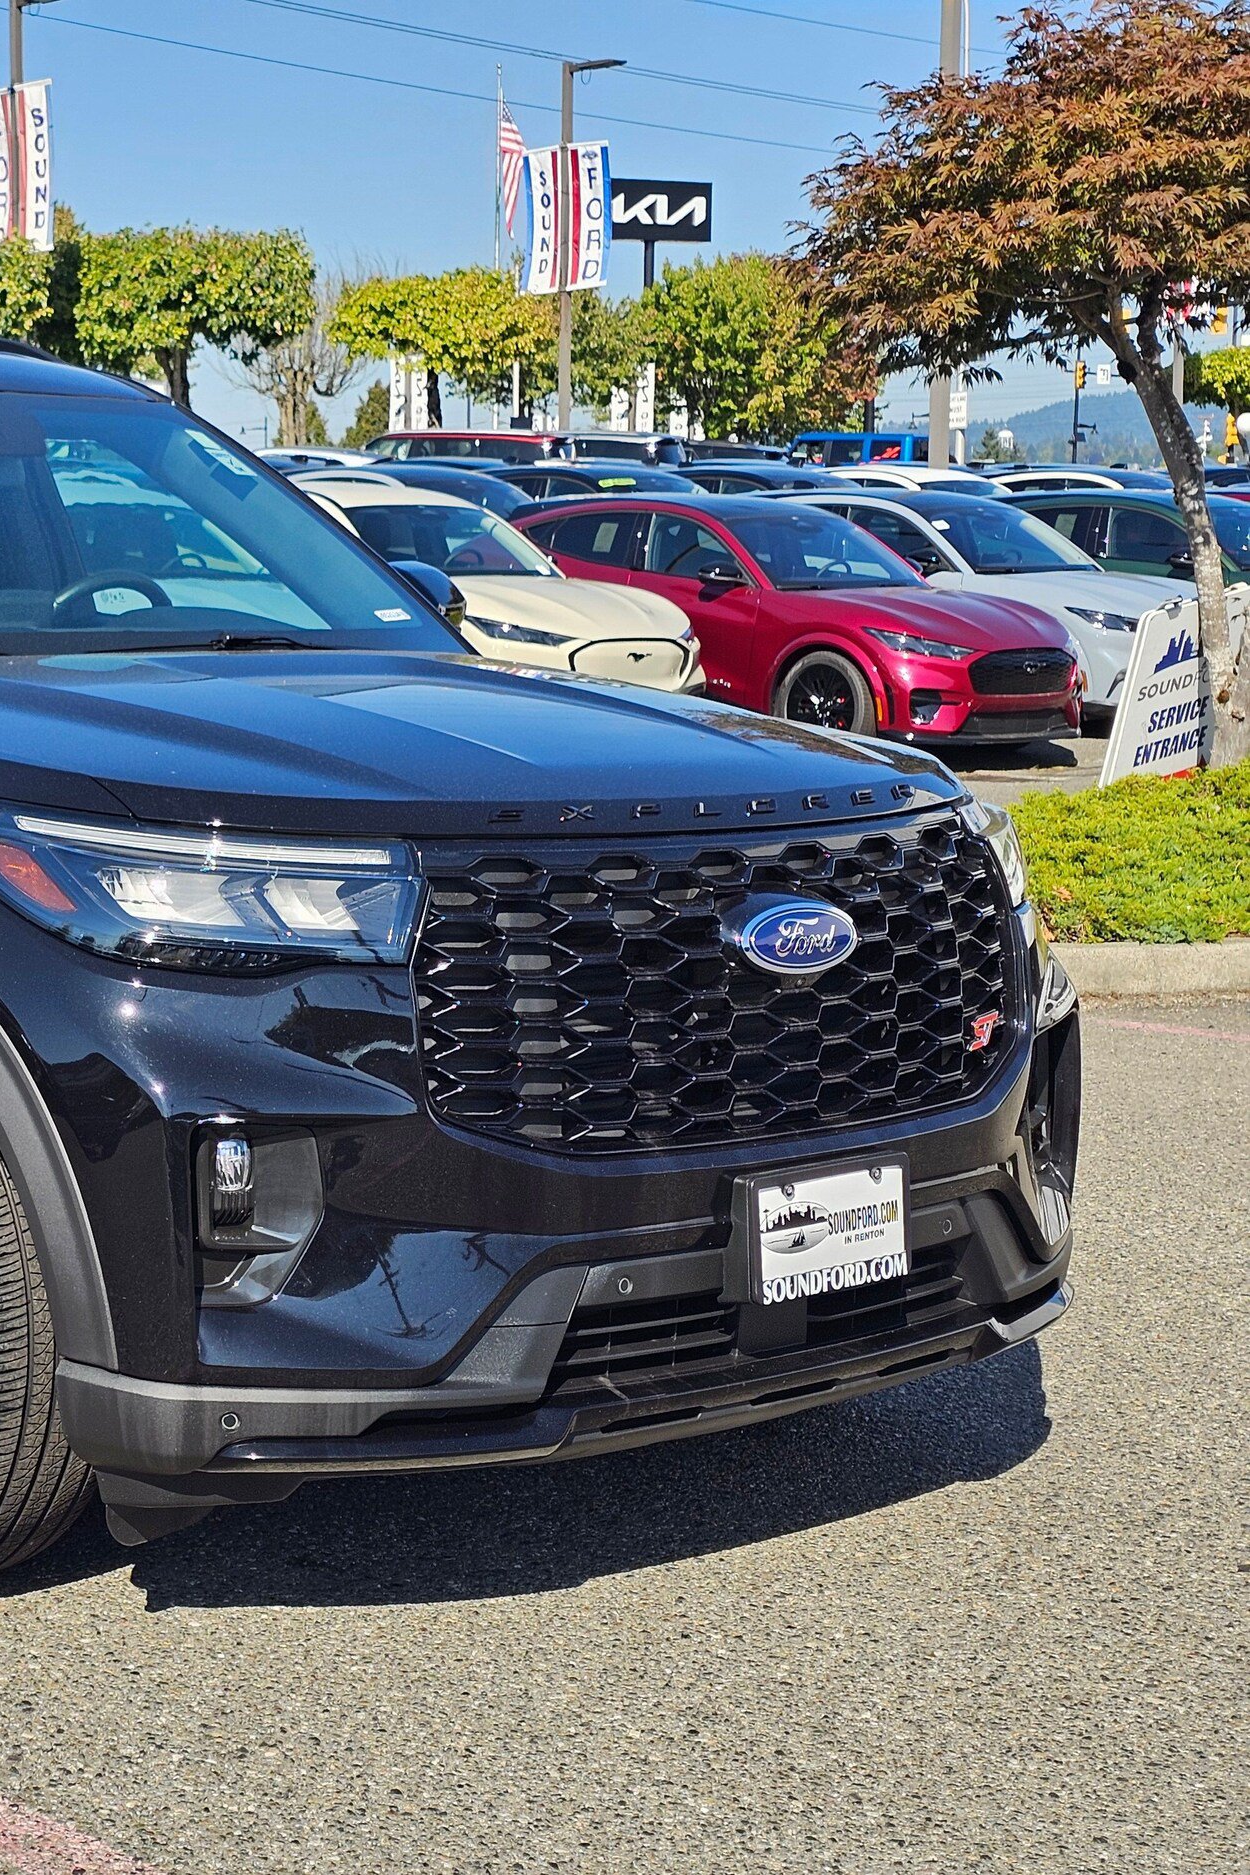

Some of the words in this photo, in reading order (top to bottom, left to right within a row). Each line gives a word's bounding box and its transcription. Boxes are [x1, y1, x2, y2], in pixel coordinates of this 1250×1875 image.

[31, 108, 47, 229] SOUND
[539, 171, 551, 274] SOUND
[582, 168, 602, 280] FORD
[1147, 695, 1210, 734] SERVICE
[1132, 725, 1209, 768] ENTRANCE
[487, 783, 916, 824] EXPLORER
[775, 916, 836, 958] Ford
[968, 1010, 999, 1052] ST
[827, 1199, 899, 1236] SOUNDFORD.COM
[844, 1235, 853, 1245] IN
[854, 1227, 885, 1244] RENTON
[762, 1252, 909, 1306] SOUNDFORD.COM
